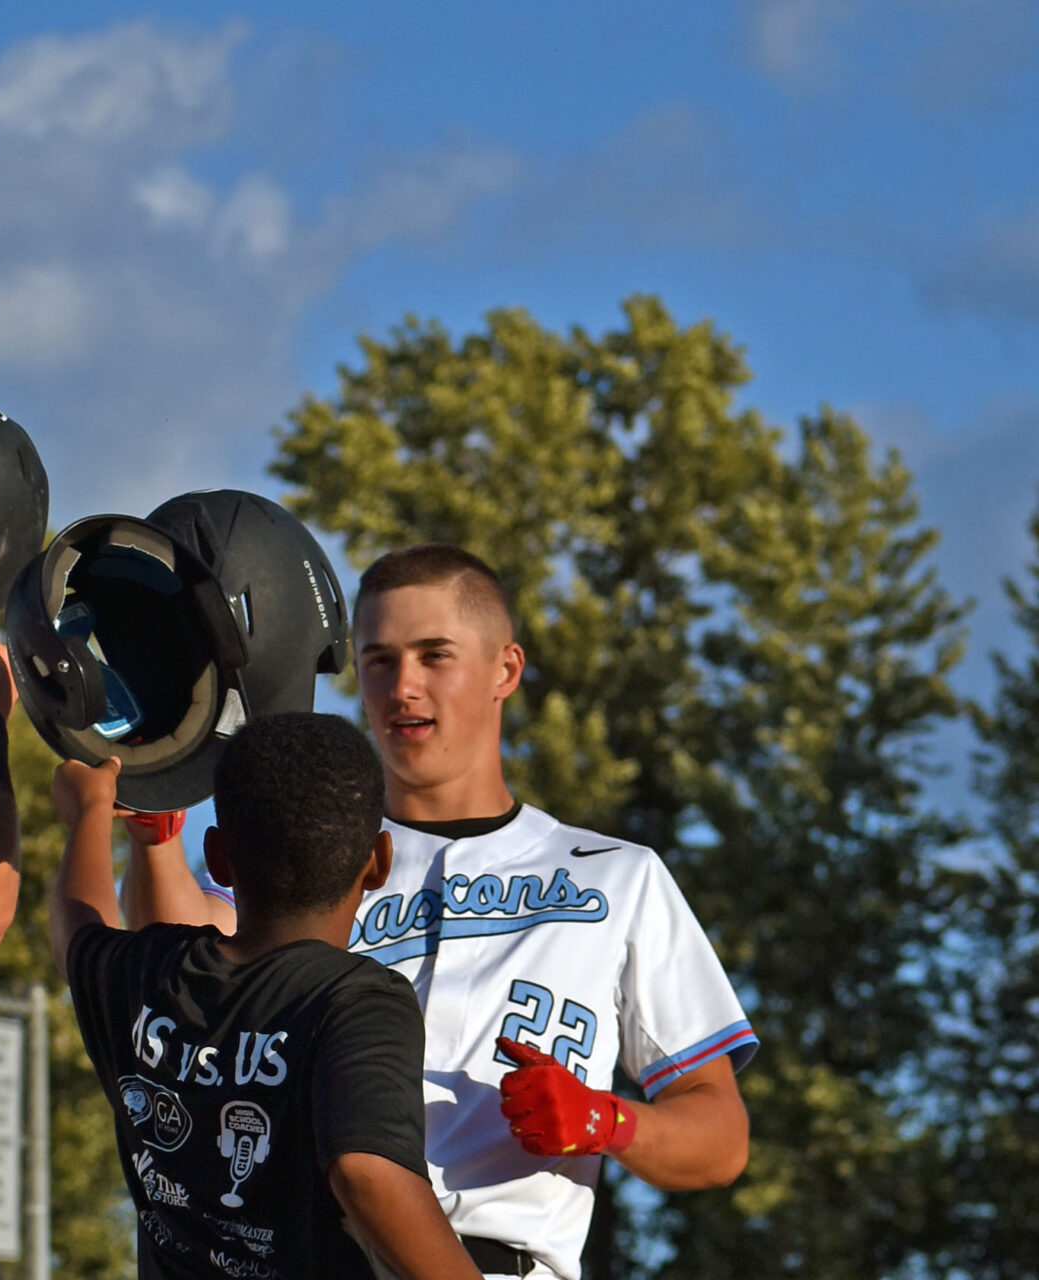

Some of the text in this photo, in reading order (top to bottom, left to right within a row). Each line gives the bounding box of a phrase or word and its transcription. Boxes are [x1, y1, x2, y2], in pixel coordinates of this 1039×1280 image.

[348, 868, 608, 948] axons
[492, 979, 597, 1085] 22
[234, 1031, 289, 1087] US
[156, 1101, 182, 1127] GA
[228, 1114, 264, 1126] SCHOOL
[236, 1140, 251, 1172] CLUB
